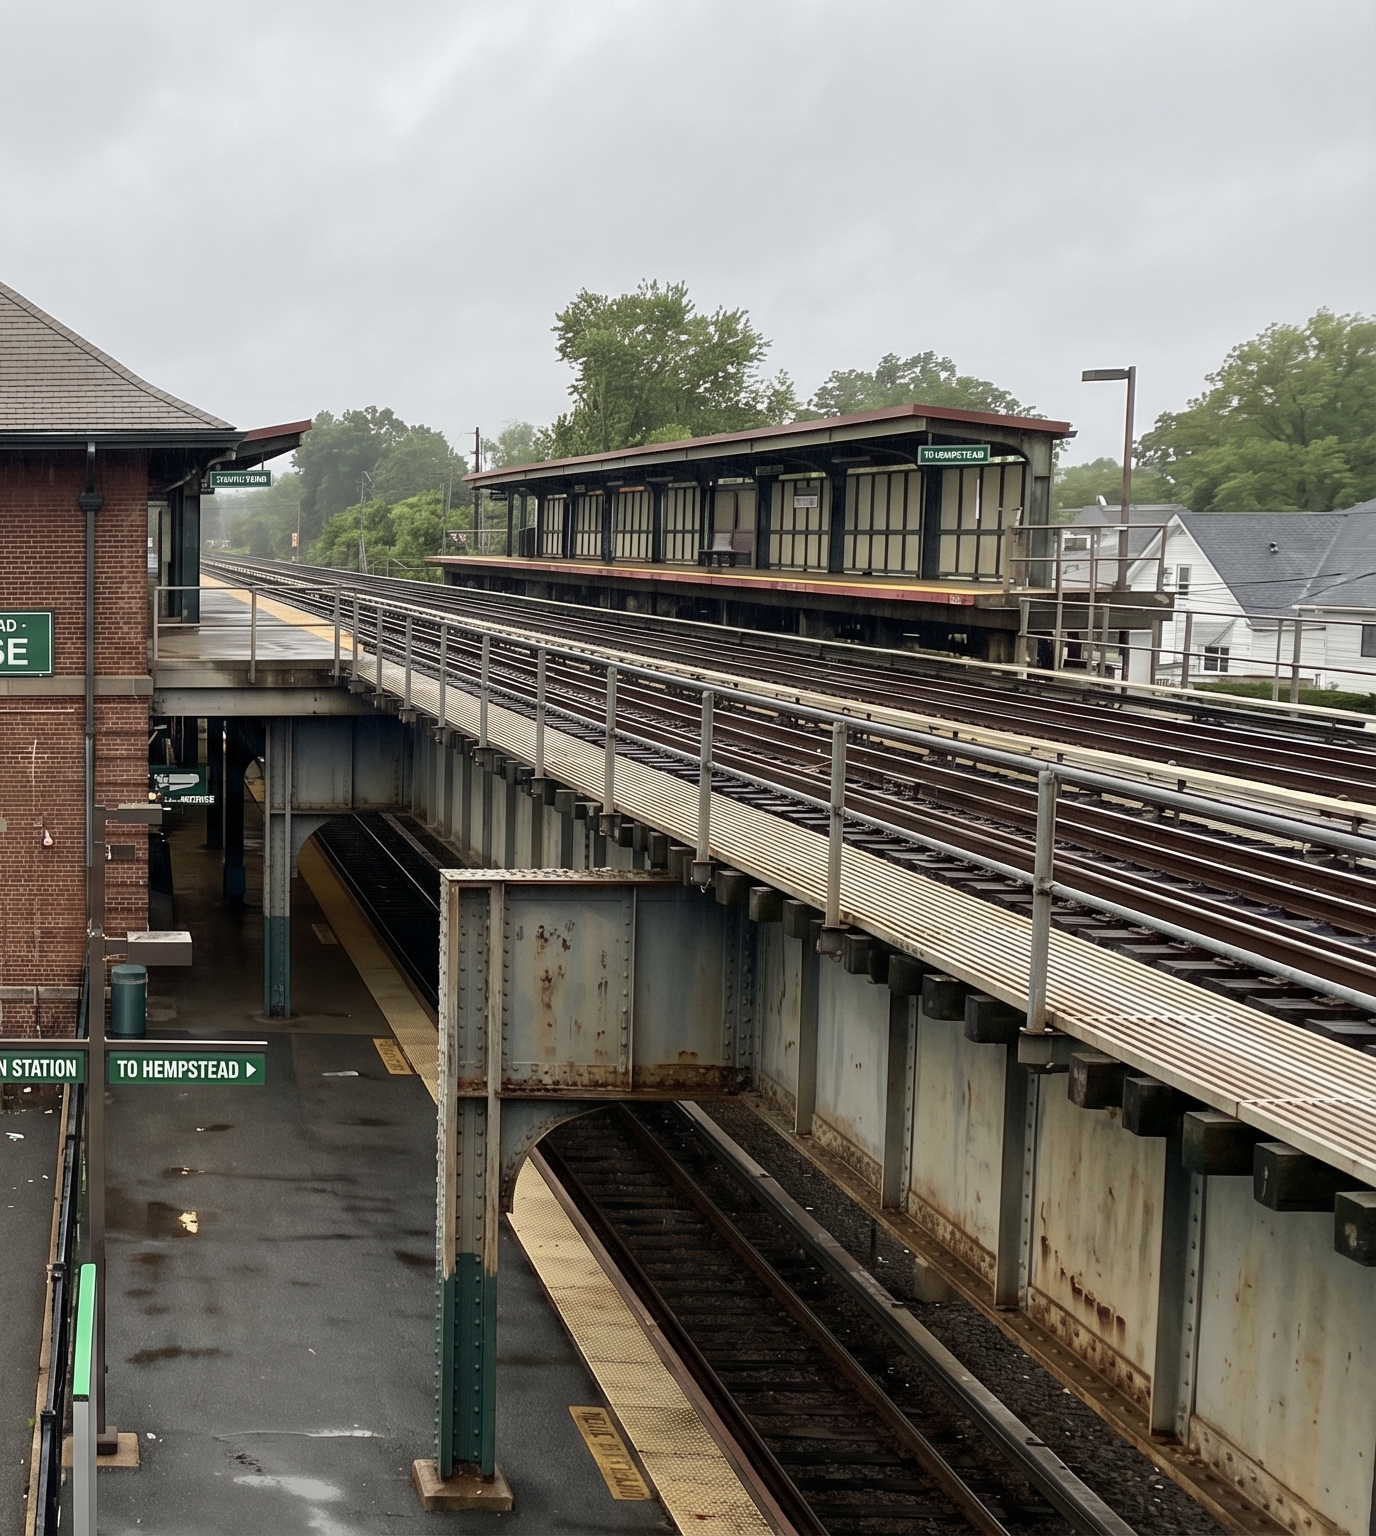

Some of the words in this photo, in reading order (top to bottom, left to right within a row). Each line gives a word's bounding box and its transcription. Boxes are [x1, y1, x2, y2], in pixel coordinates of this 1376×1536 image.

[12, 1058, 77, 1078] STATION
[117, 1059, 138, 1078] TO
[142, 1060, 239, 1079] HEMPSTEAD
